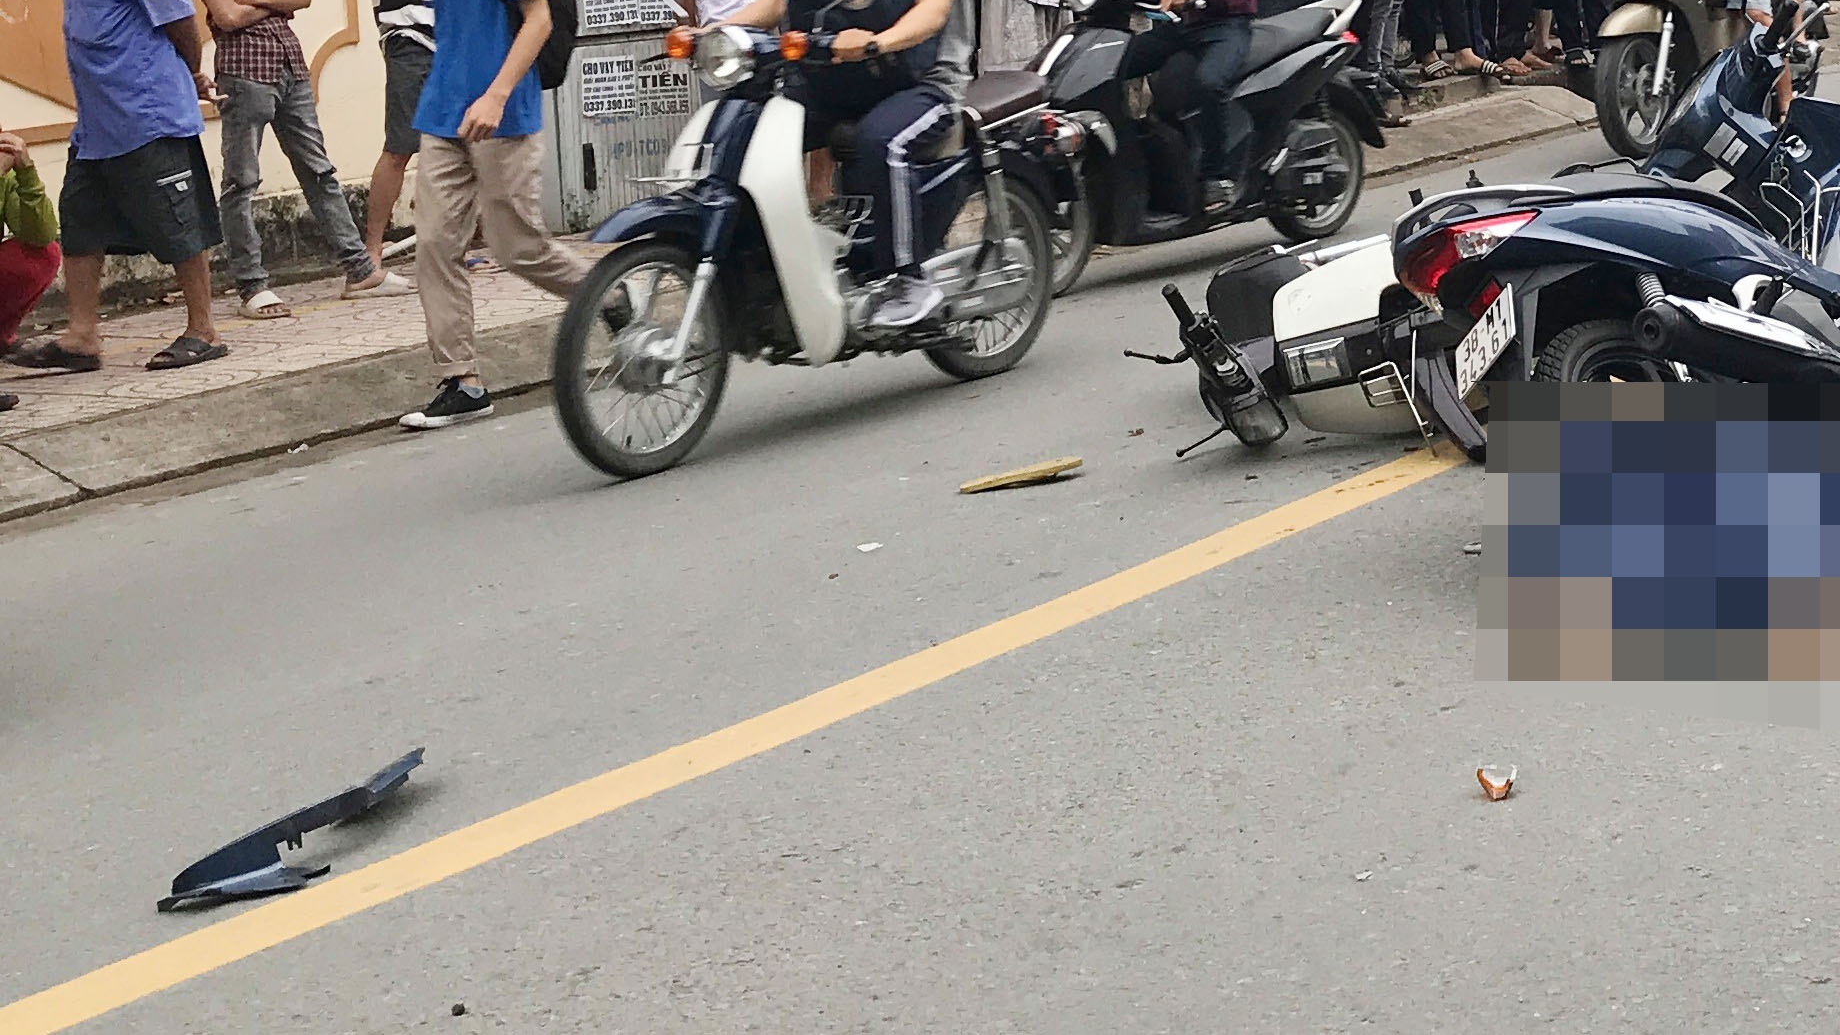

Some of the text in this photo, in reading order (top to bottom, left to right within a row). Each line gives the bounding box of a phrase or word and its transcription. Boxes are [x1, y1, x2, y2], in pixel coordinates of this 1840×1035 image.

[582, 62, 598, 76] CHO
[599, 61, 614, 74] VAY
[1460, 318, 1509, 395] 343.61
